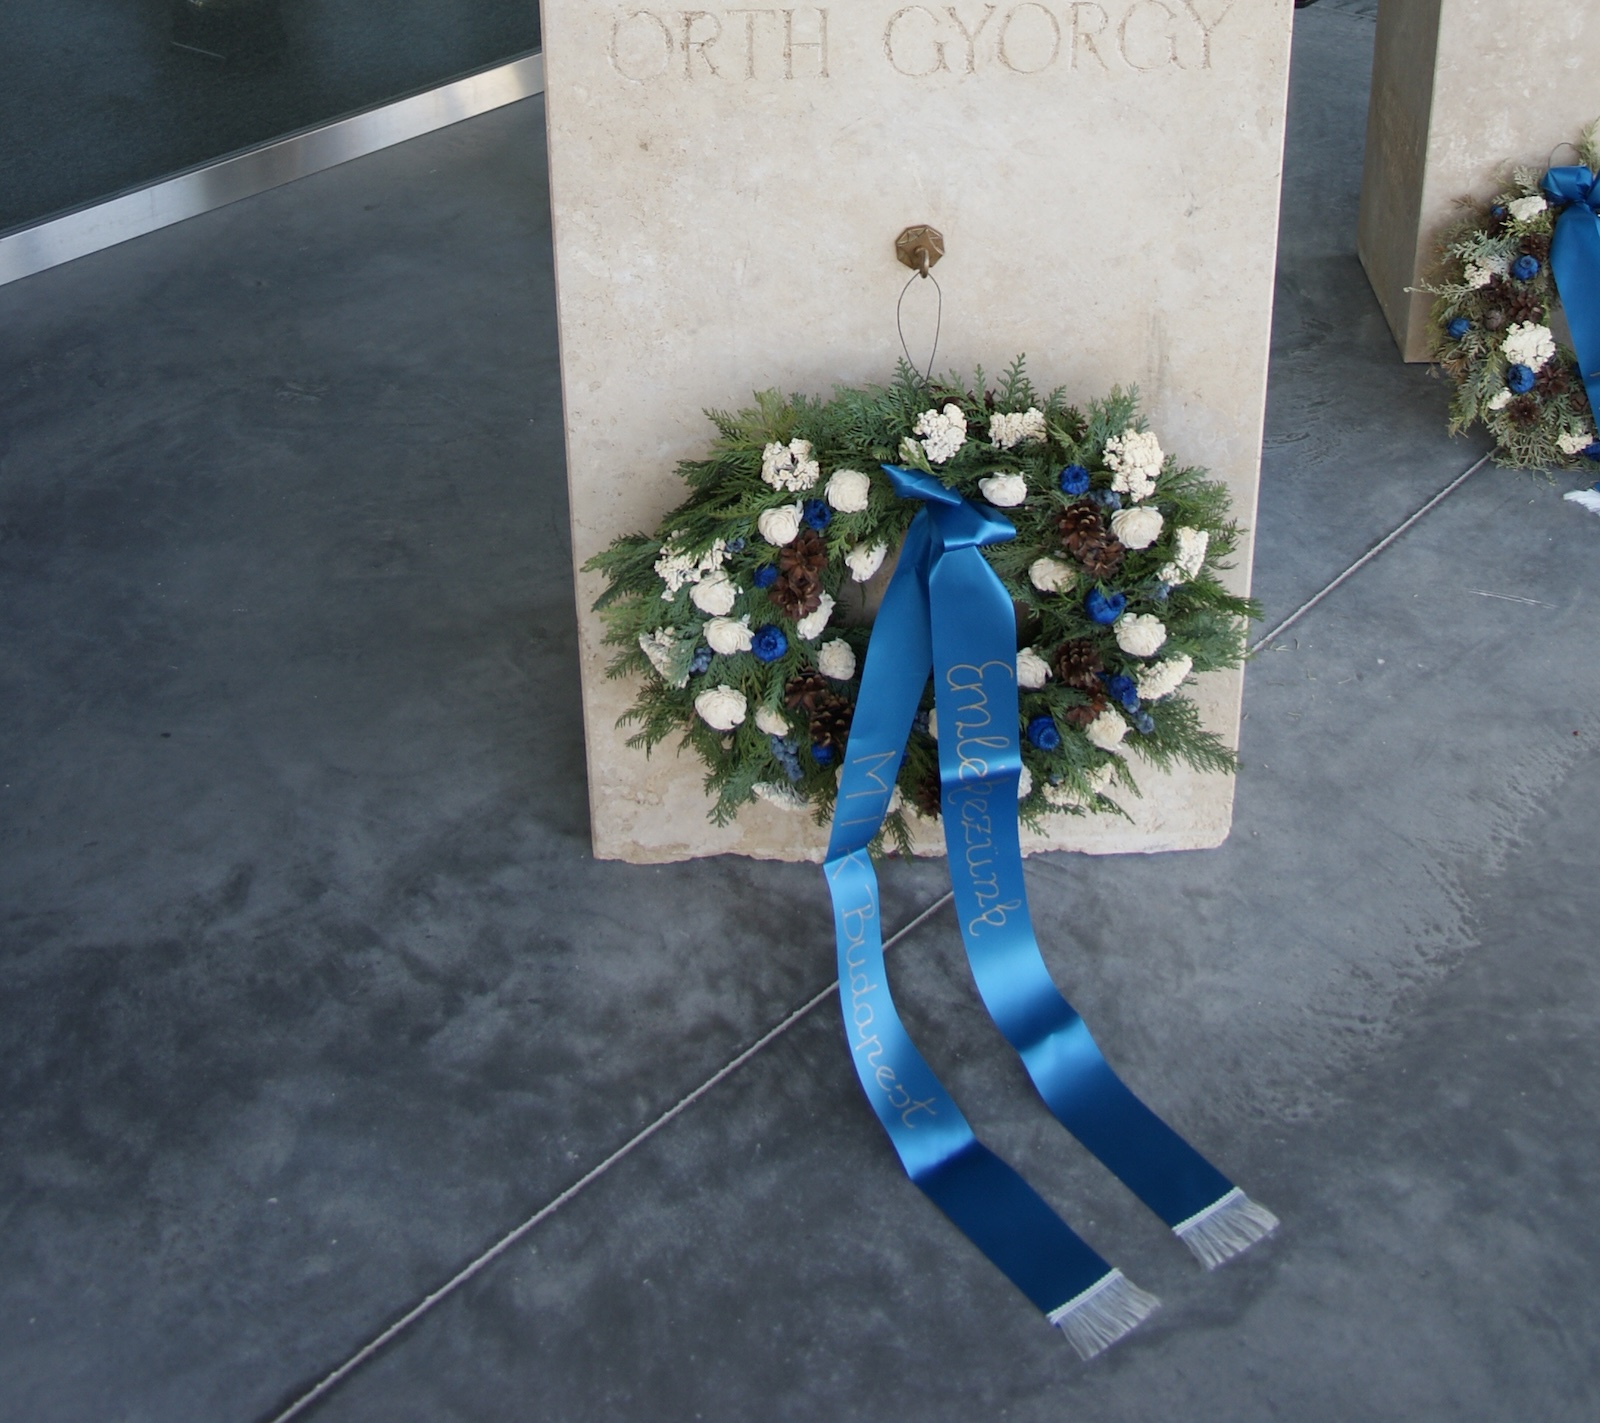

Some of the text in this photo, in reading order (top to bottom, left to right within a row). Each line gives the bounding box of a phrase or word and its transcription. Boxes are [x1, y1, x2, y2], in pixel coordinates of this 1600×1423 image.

[605, 7, 831, 80] ORTH
[831, 750, 938, 1129] MTK Budapest
